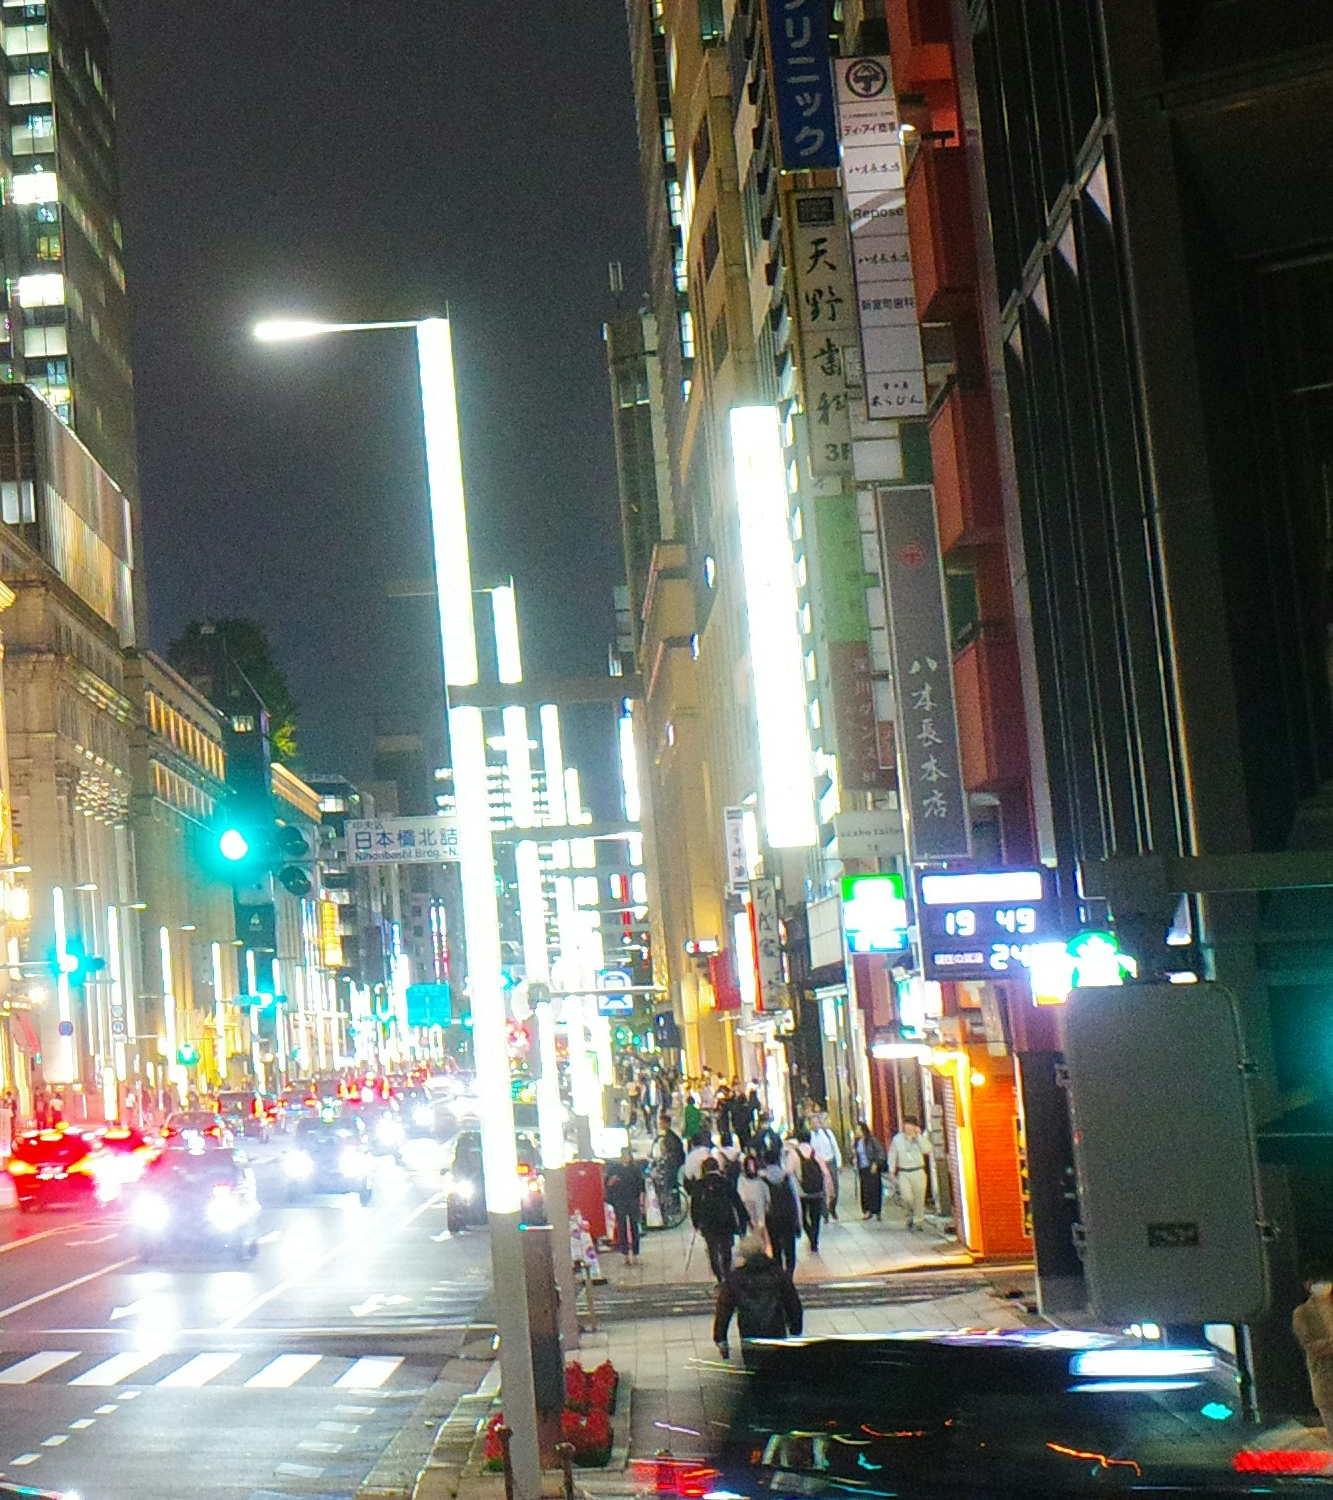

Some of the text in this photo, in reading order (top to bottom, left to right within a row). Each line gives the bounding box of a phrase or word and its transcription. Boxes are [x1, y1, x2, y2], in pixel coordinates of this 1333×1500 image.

[852, 208, 904, 220] Repose
[354, 827, 458, 850] 日本橋北詰
[945, 907, 1035, 936] 19 49
